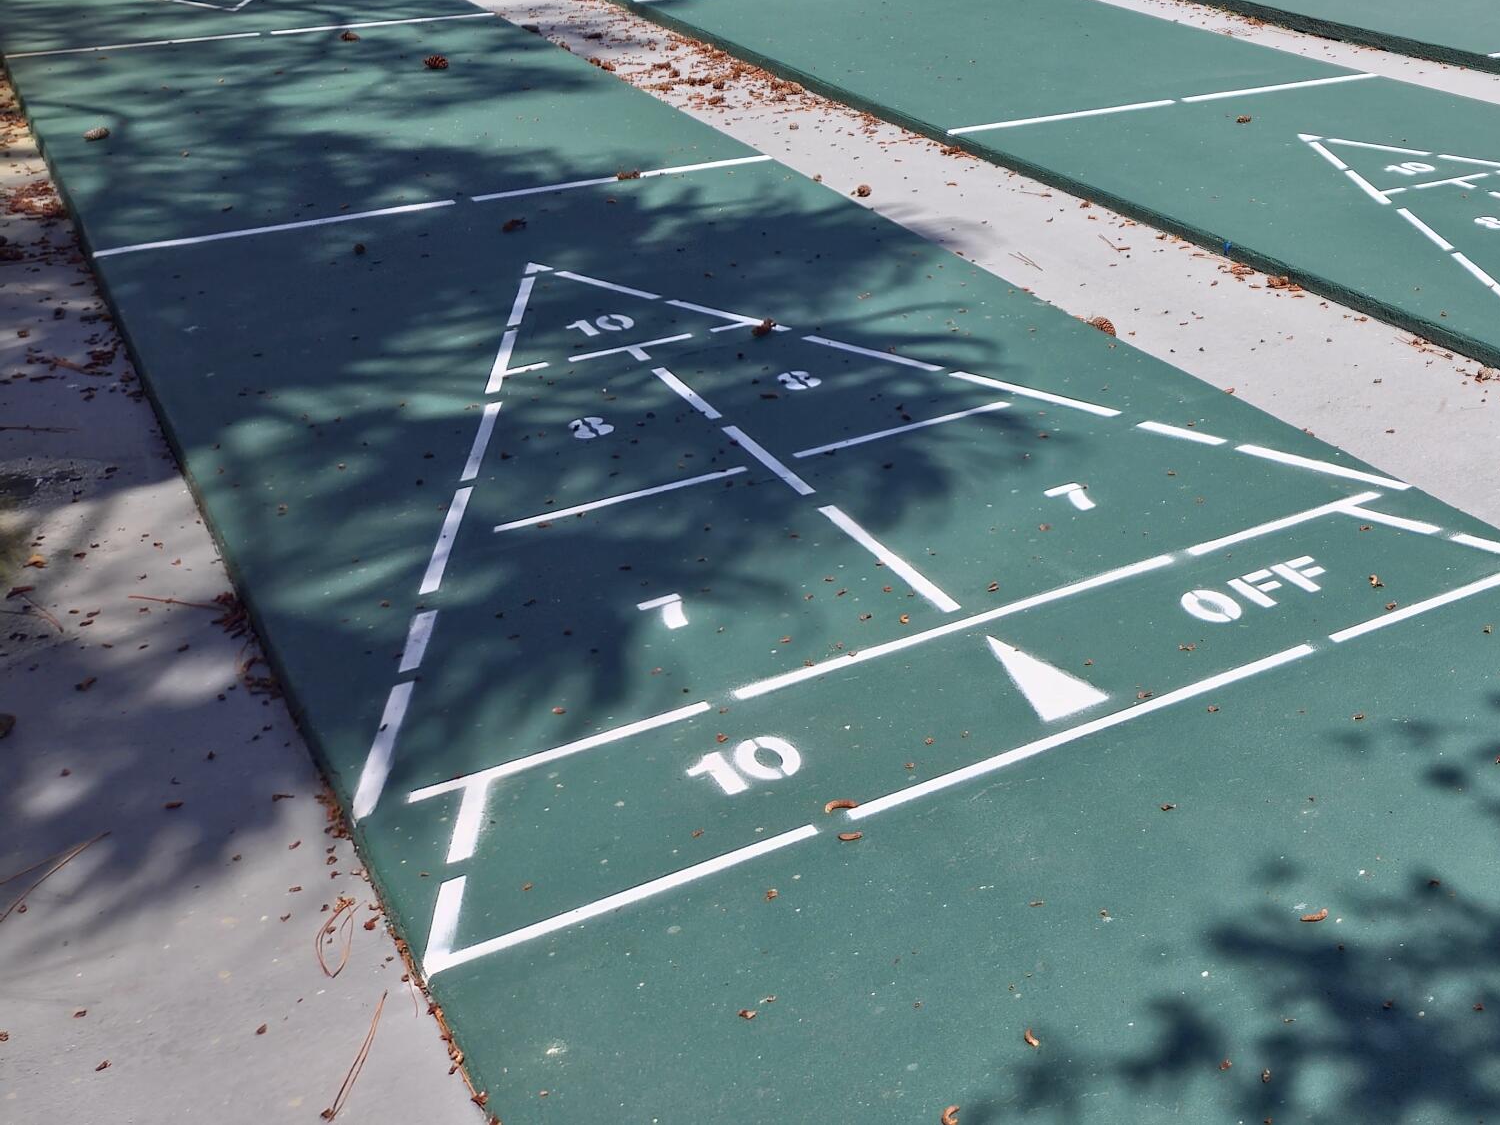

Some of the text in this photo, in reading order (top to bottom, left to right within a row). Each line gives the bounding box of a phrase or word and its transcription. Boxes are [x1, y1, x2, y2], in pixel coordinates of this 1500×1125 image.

[1385, 162, 1435, 175] 10
[566, 315, 633, 336] 10
[778, 372, 821, 390] 8
[570, 417, 614, 438] 8
[1044, 483, 1095, 510] 7
[1181, 555, 1326, 623] OFF
[638, 594, 688, 629] 7
[686, 736, 801, 795] 10
